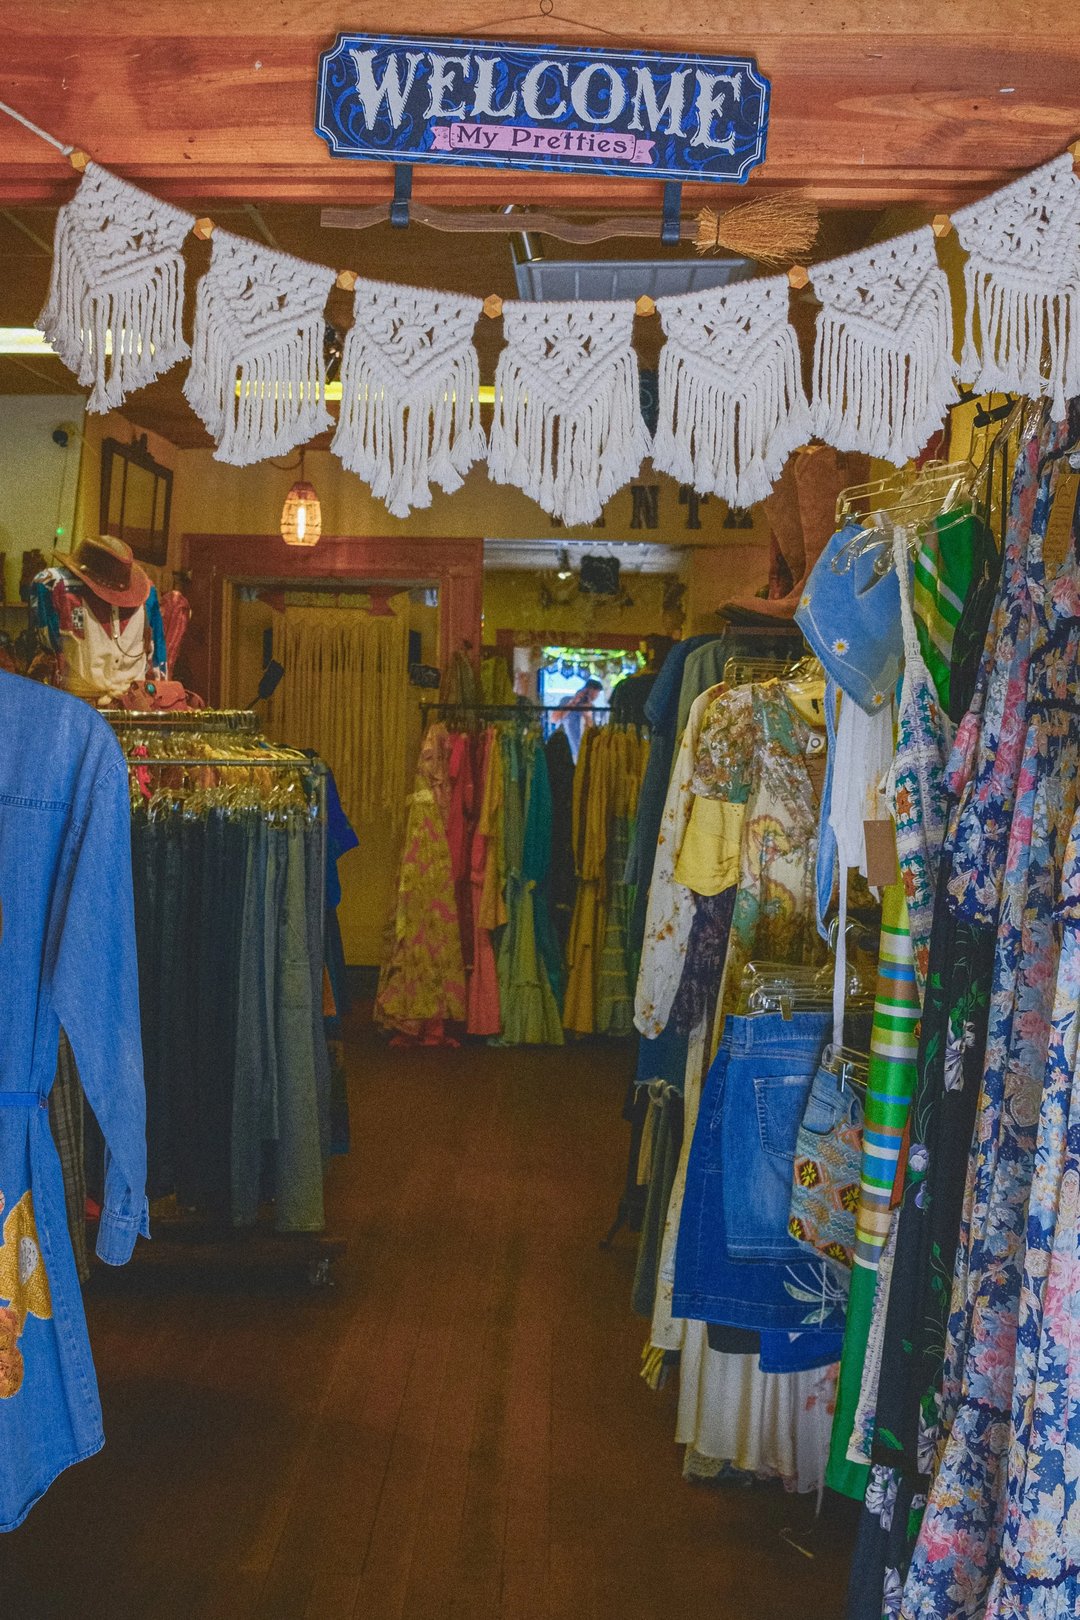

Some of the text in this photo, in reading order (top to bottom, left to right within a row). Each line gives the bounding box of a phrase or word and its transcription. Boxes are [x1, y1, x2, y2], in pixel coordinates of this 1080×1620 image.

[349, 48, 743, 155] WELCOME
[456, 125, 628, 154] My Pretties
